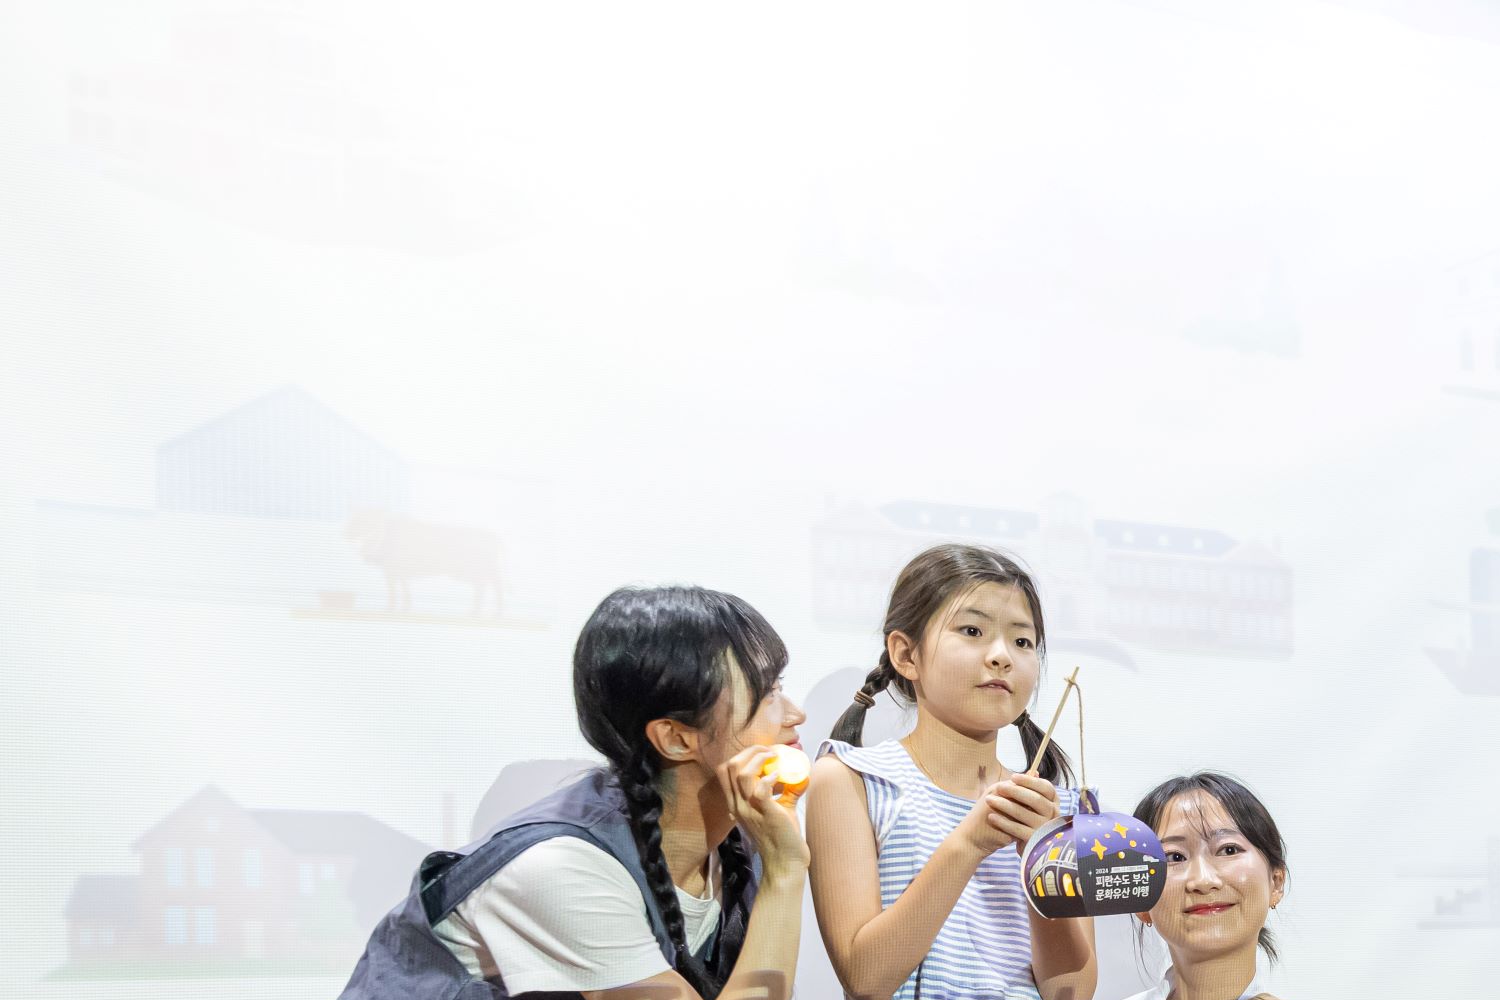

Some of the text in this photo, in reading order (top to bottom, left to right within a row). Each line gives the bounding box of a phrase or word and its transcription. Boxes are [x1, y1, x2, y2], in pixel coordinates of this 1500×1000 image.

[1095, 872, 1150, 888] 피란수도 부산
[1095, 887, 1131, 901] 문화유산
